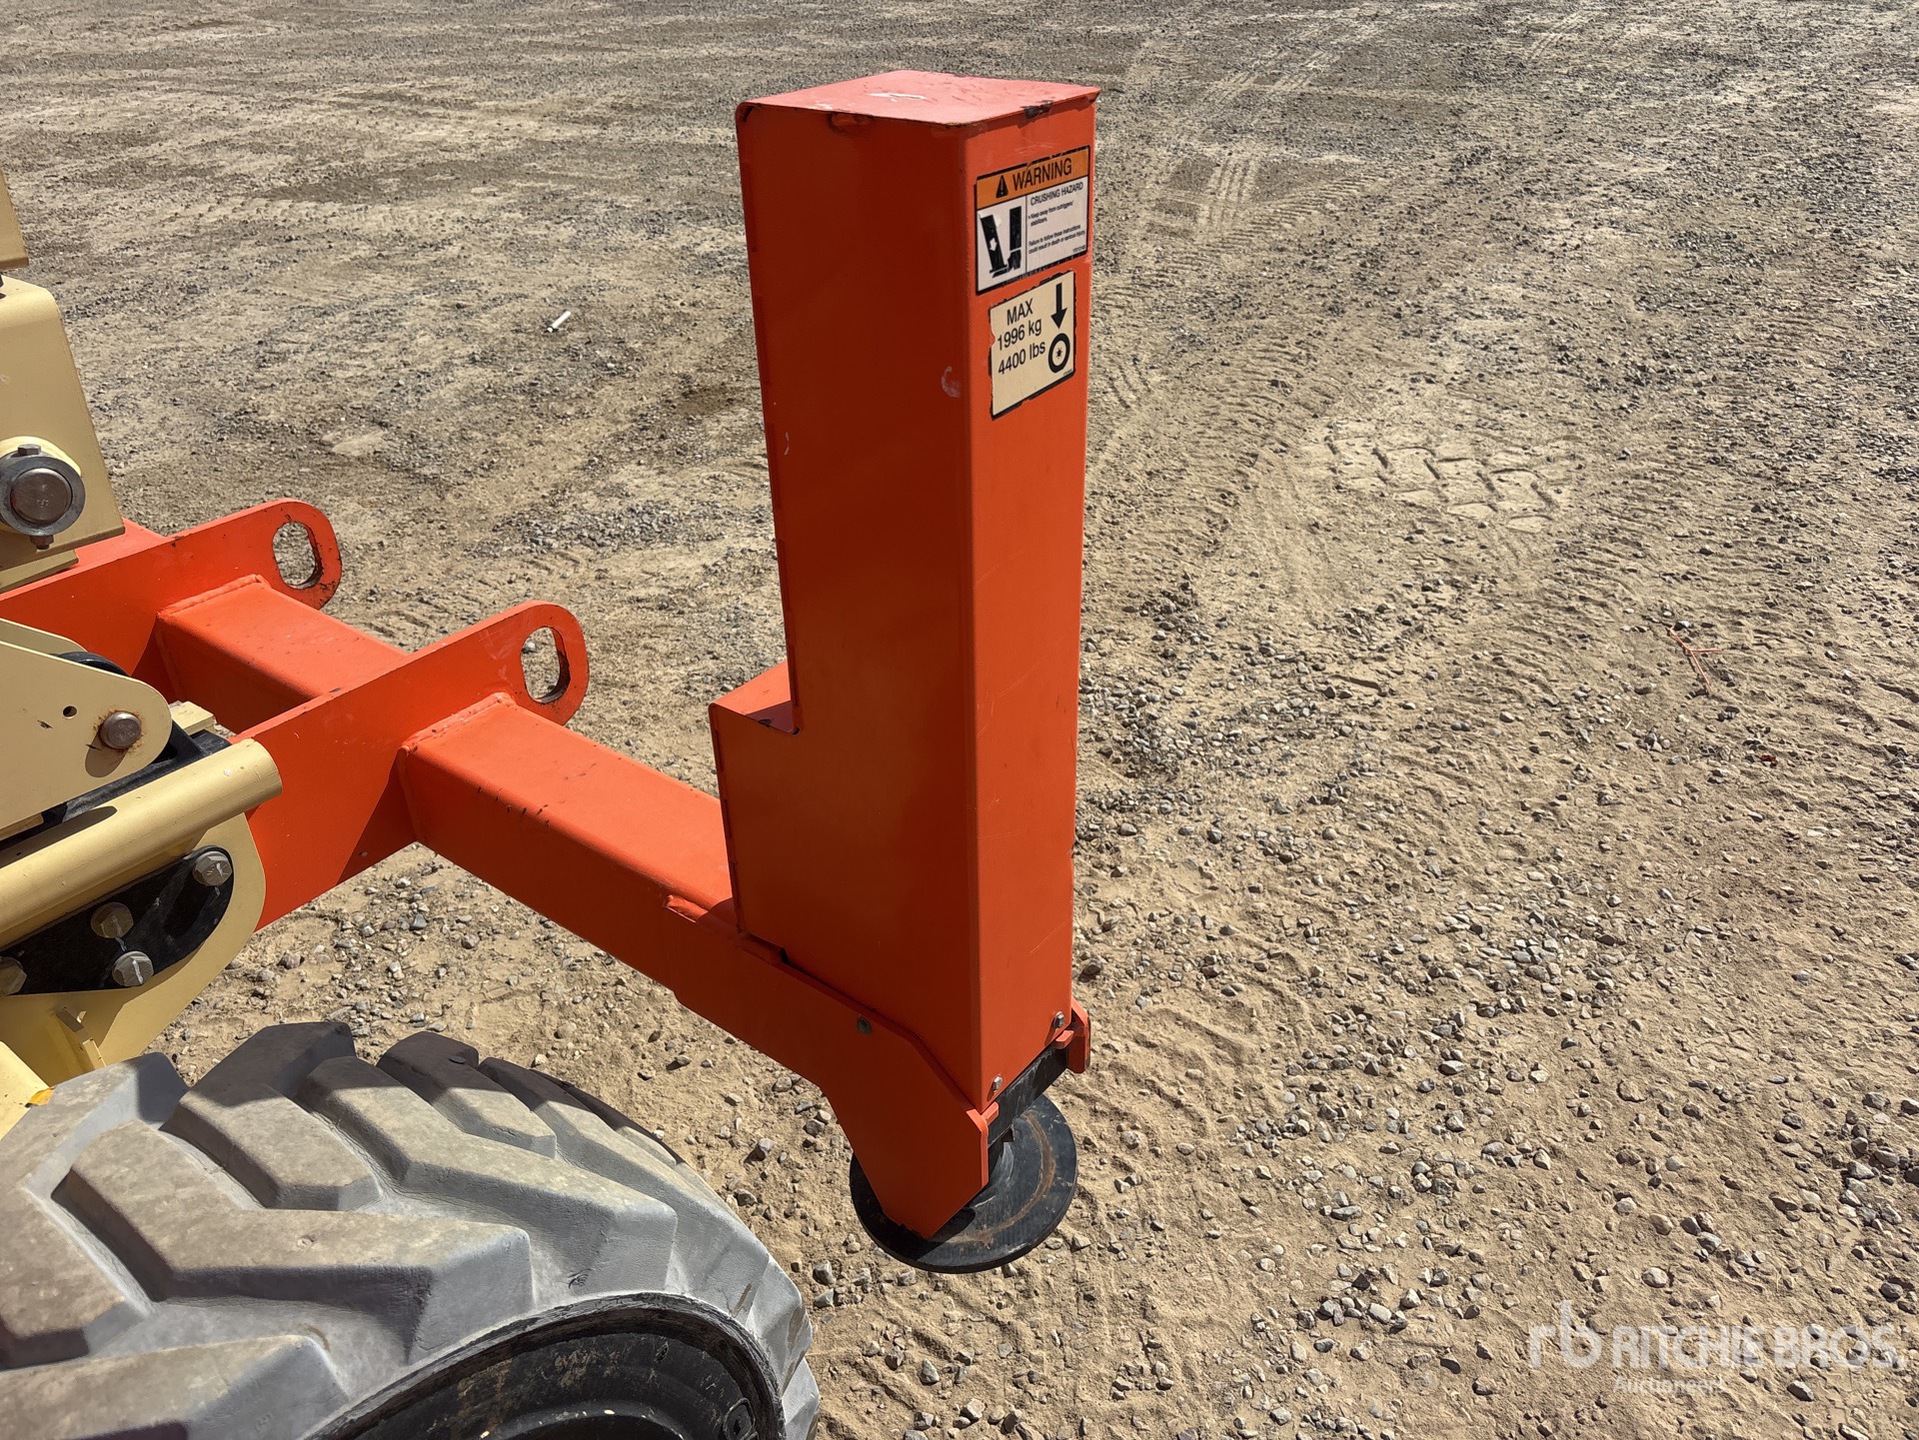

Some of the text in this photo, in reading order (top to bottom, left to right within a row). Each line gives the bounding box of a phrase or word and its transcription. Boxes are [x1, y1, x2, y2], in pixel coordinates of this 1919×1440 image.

[1012, 158, 1072, 191] WARNING
[1030, 182, 1084, 206] CRUSHING HAZARD
[1006, 298, 1034, 326] MAX
[997, 318, 1042, 350] 1996 kg
[998, 341, 1046, 375] 4400 lbs
